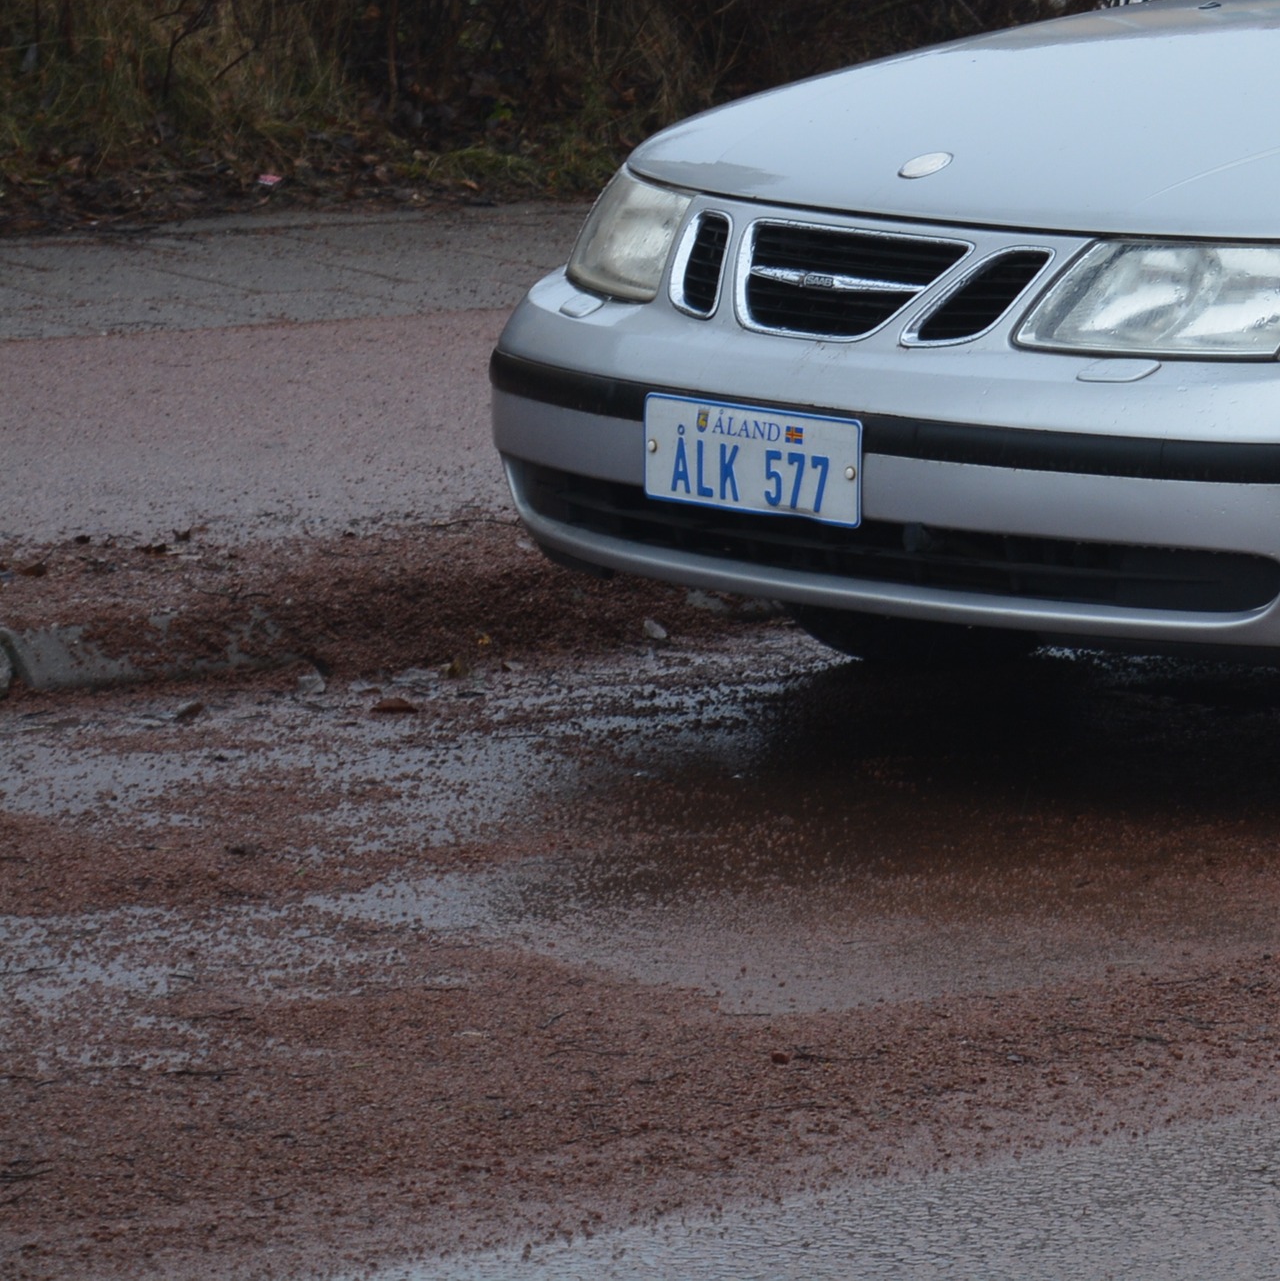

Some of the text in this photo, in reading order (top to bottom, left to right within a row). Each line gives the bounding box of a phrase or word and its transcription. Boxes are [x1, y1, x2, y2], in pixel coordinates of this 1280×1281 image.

[806, 275, 832, 287] SAAB
[712, 409, 781, 442] ÅLAND
[671, 424, 829, 513] ÅLK 577
